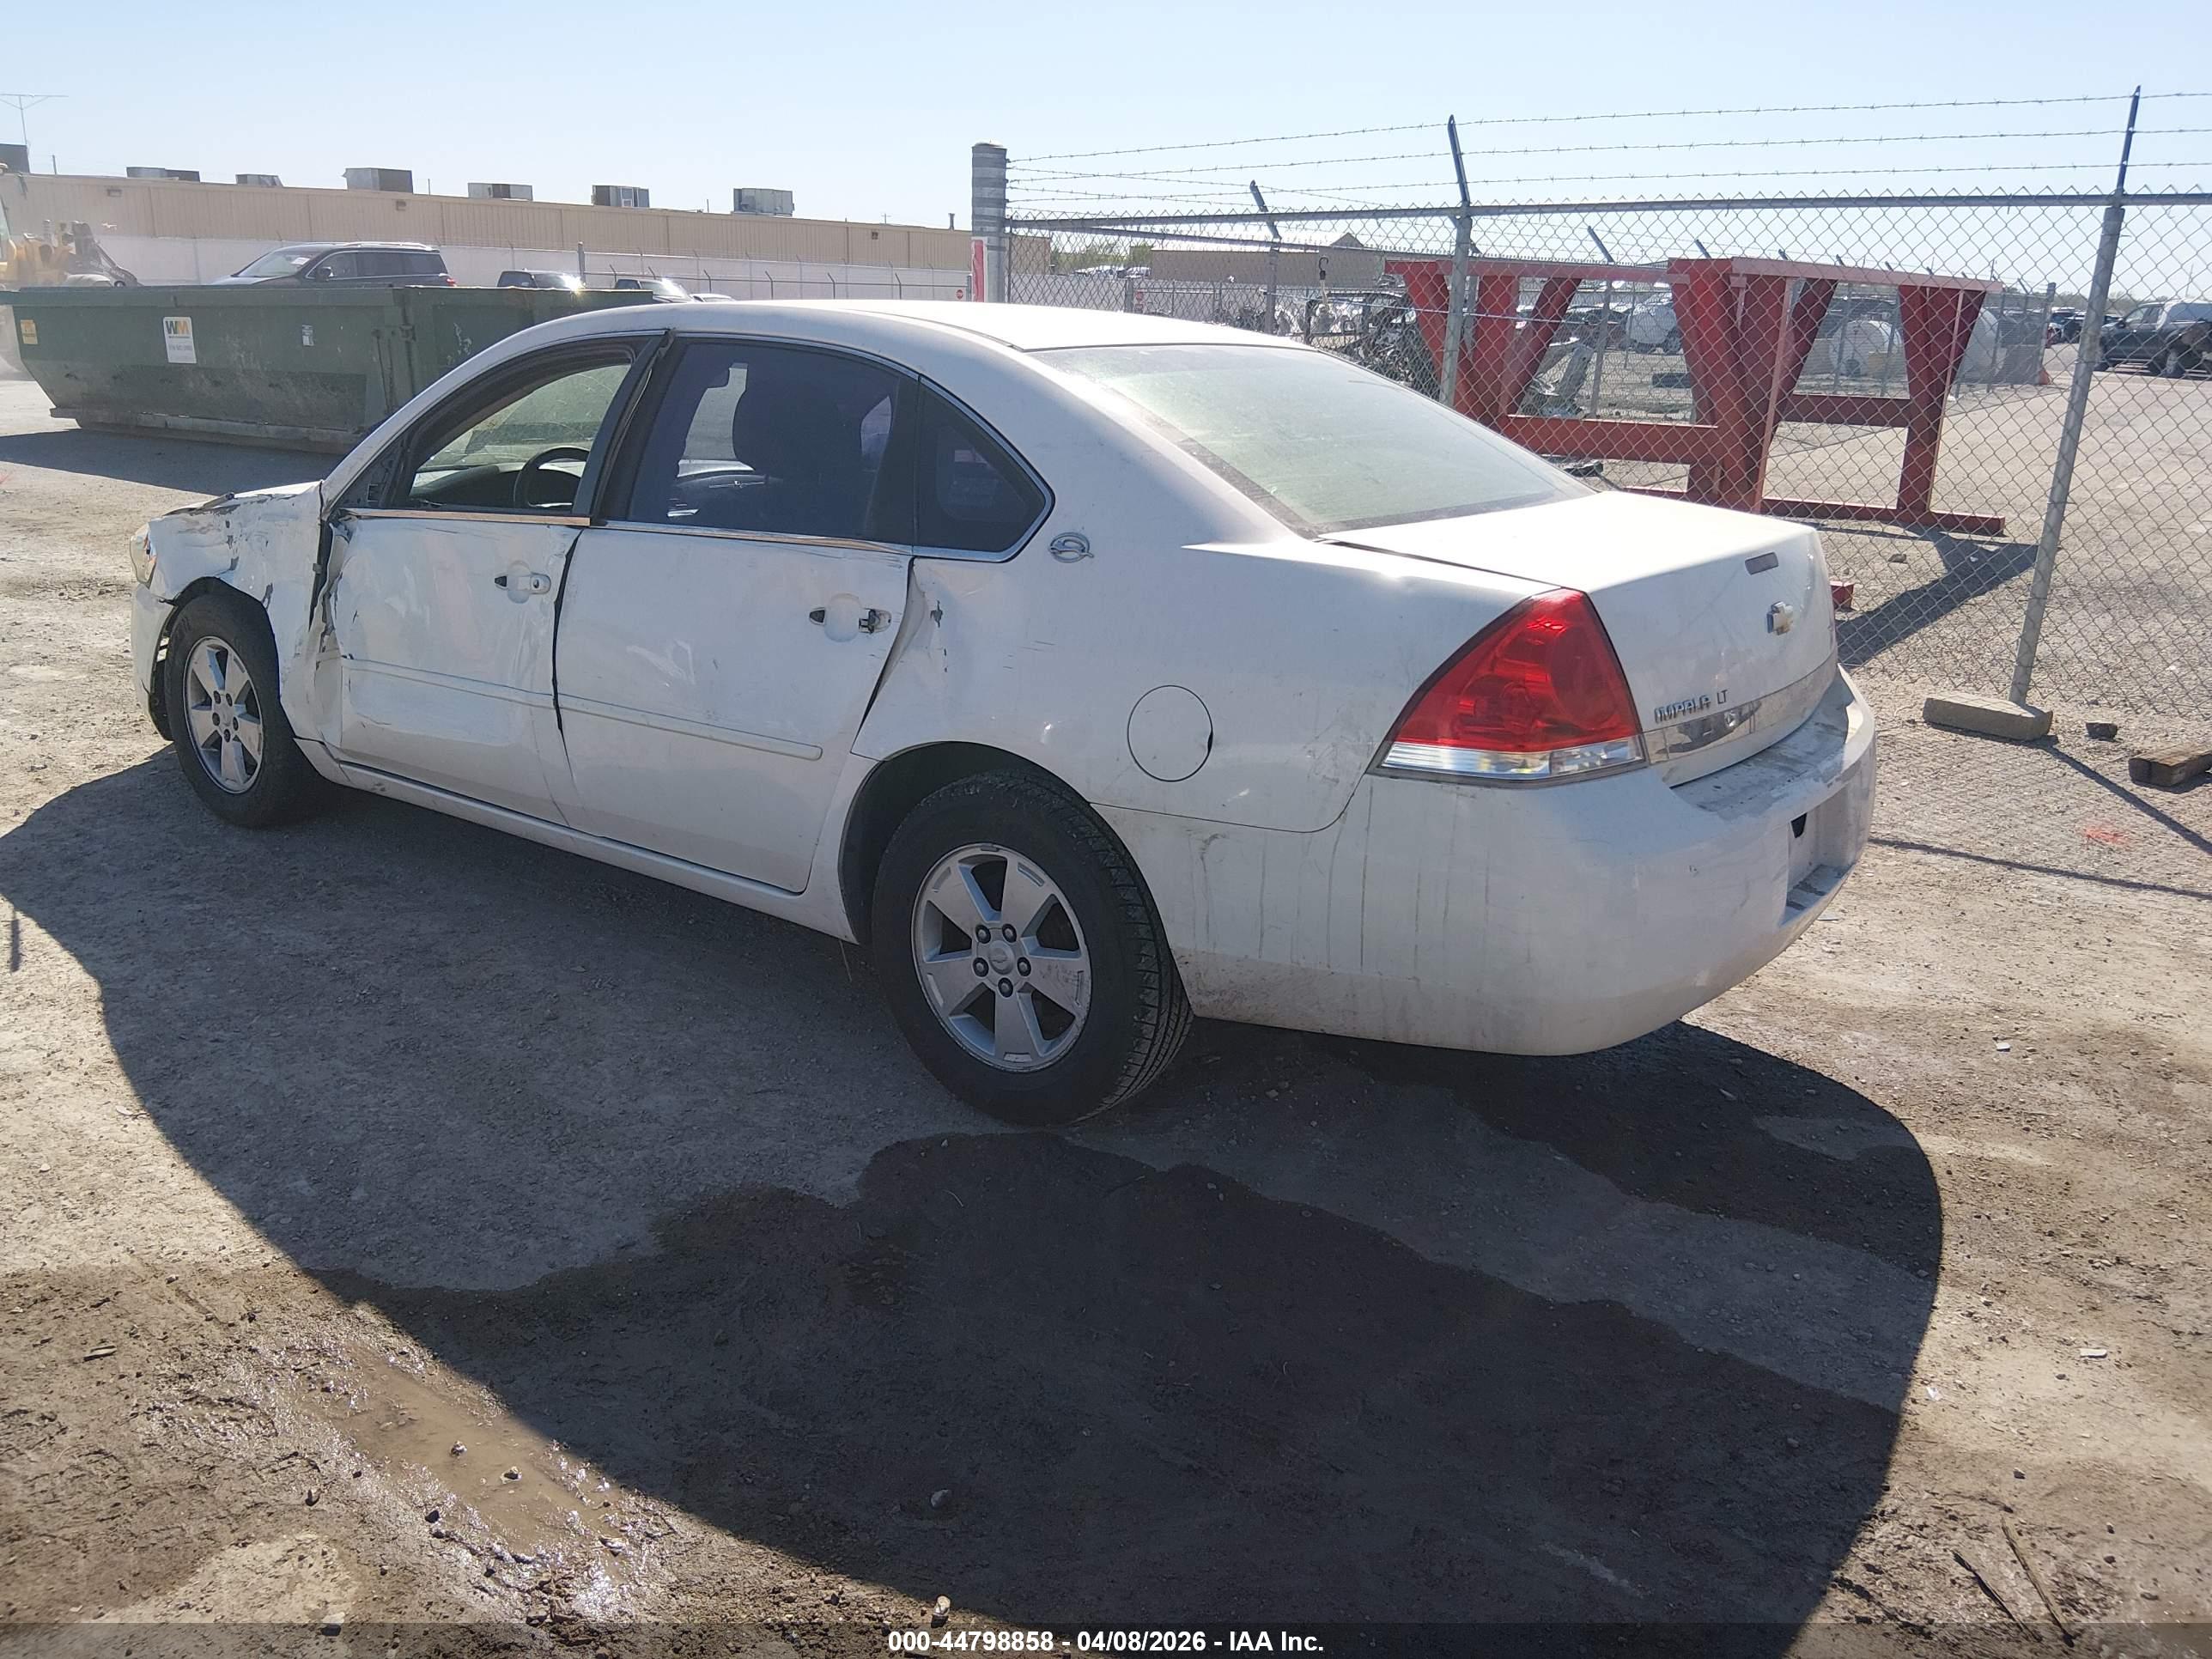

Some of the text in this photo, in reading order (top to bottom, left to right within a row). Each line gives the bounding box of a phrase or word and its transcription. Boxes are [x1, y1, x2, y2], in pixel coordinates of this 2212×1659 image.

[165, 320, 190, 335] WM
[1654, 689, 1728, 723] IMPALA LT
